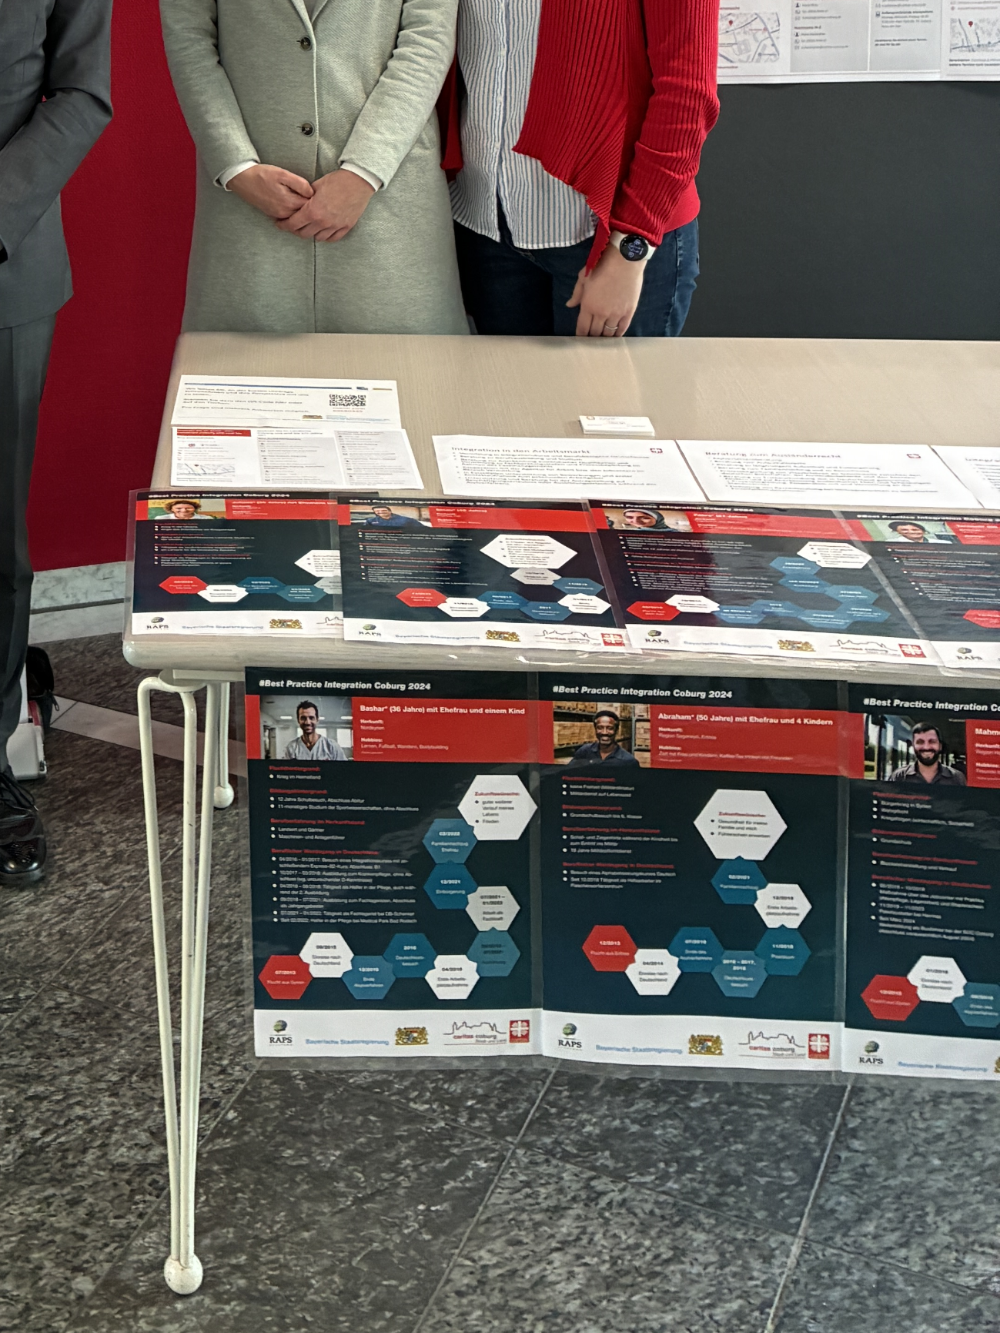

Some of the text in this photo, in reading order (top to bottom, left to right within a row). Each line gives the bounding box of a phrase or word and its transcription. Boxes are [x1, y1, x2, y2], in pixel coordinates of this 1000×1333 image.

[286, 680, 322, 688] Practice
[324, 681, 372, 689] Integration
[375, 682, 405, 690] Coburg
[581, 686, 618, 694] Practice
[620, 687, 671, 697] Integration
[673, 689, 706, 699] Coburg
[864, 698, 891, 706] #Best
[893, 699, 933, 709] Practice
[935, 702, 987, 711] Integration
[710, 714, 733, 723] Jahre)
[749, 716, 778, 724] Ehefrau
[803, 718, 833, 726] Kindern
[269, 1036, 292, 1044] RAPS
[558, 1039, 582, 1048] RAPS
